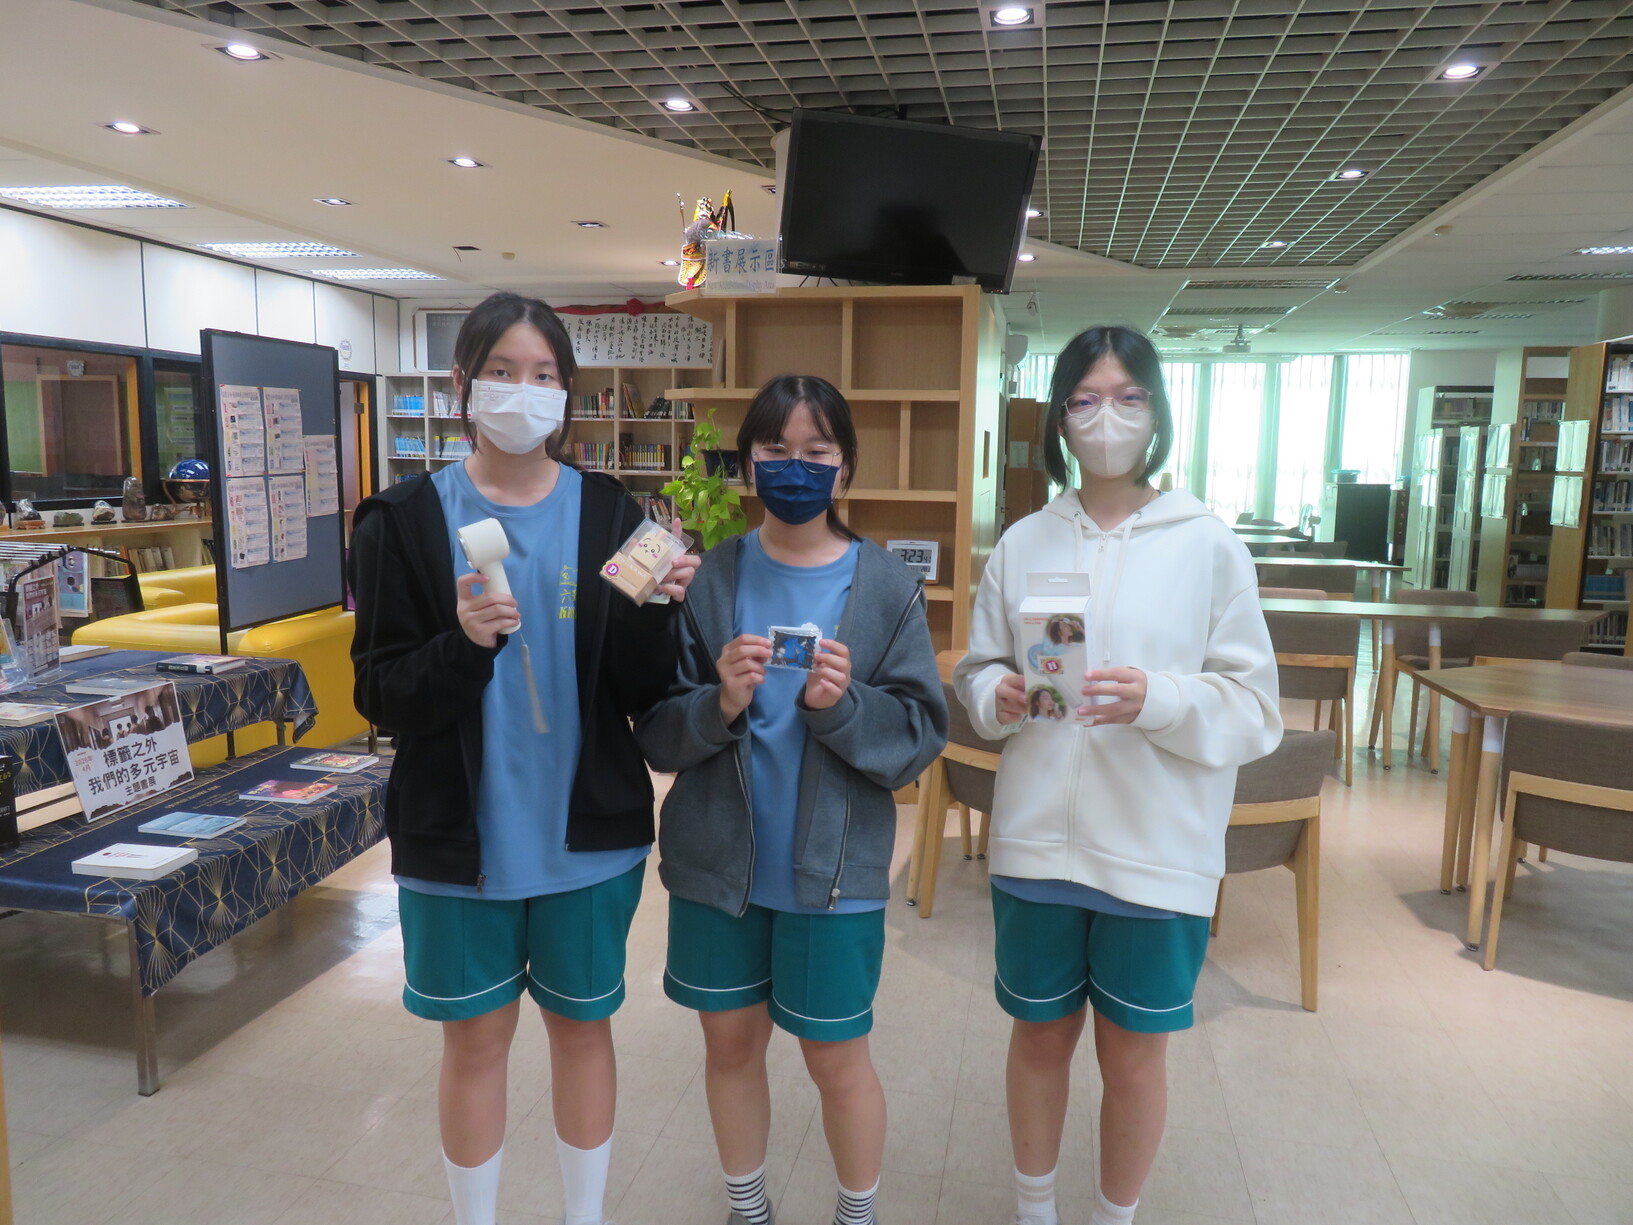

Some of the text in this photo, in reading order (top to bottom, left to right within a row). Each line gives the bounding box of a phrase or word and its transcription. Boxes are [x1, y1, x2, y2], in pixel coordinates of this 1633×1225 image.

[707, 245, 774, 275] 新書展示區
[607, 565, 617, 575] D
[102, 736, 158, 768] 標籤之外
[88, 749, 180, 796] 我們的多元宇宙
[125, 775, 157, 797] 主題書展
